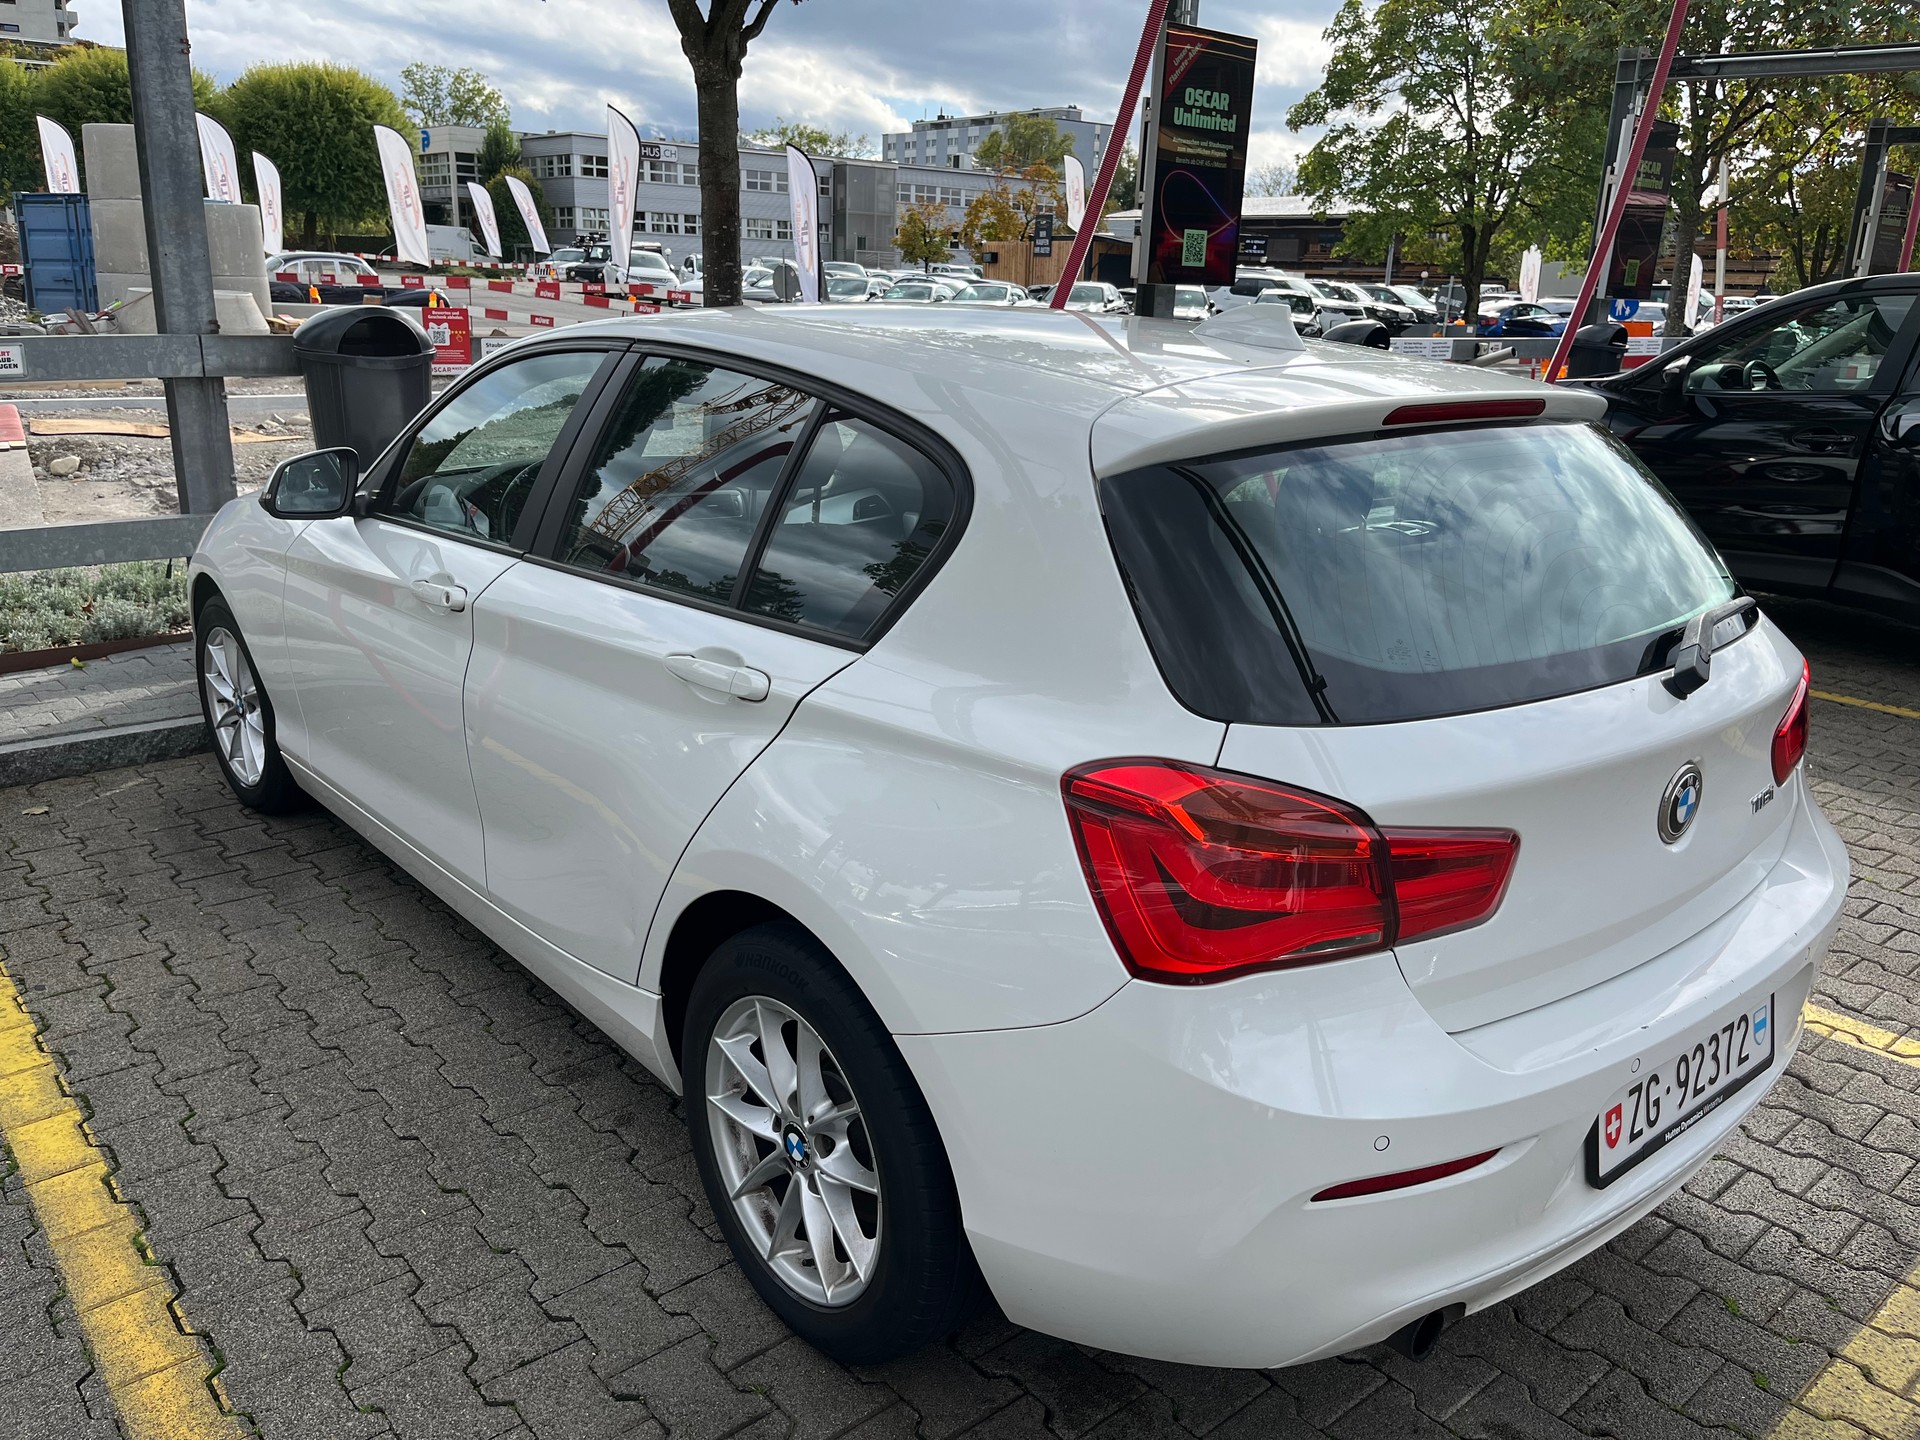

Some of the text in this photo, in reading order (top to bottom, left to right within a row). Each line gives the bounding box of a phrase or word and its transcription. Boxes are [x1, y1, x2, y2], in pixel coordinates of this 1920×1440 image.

[1184, 87, 1230, 111] OSCAR
[1173, 106, 1238, 133] Unlimited
[586, 283, 602, 291] BÜWE
[539, 289, 556, 299] BÜWE
[671, 291, 687, 300] BÜWE
[638, 304, 656, 313] BÜWE
[534, 315, 550, 325] BÜWE
